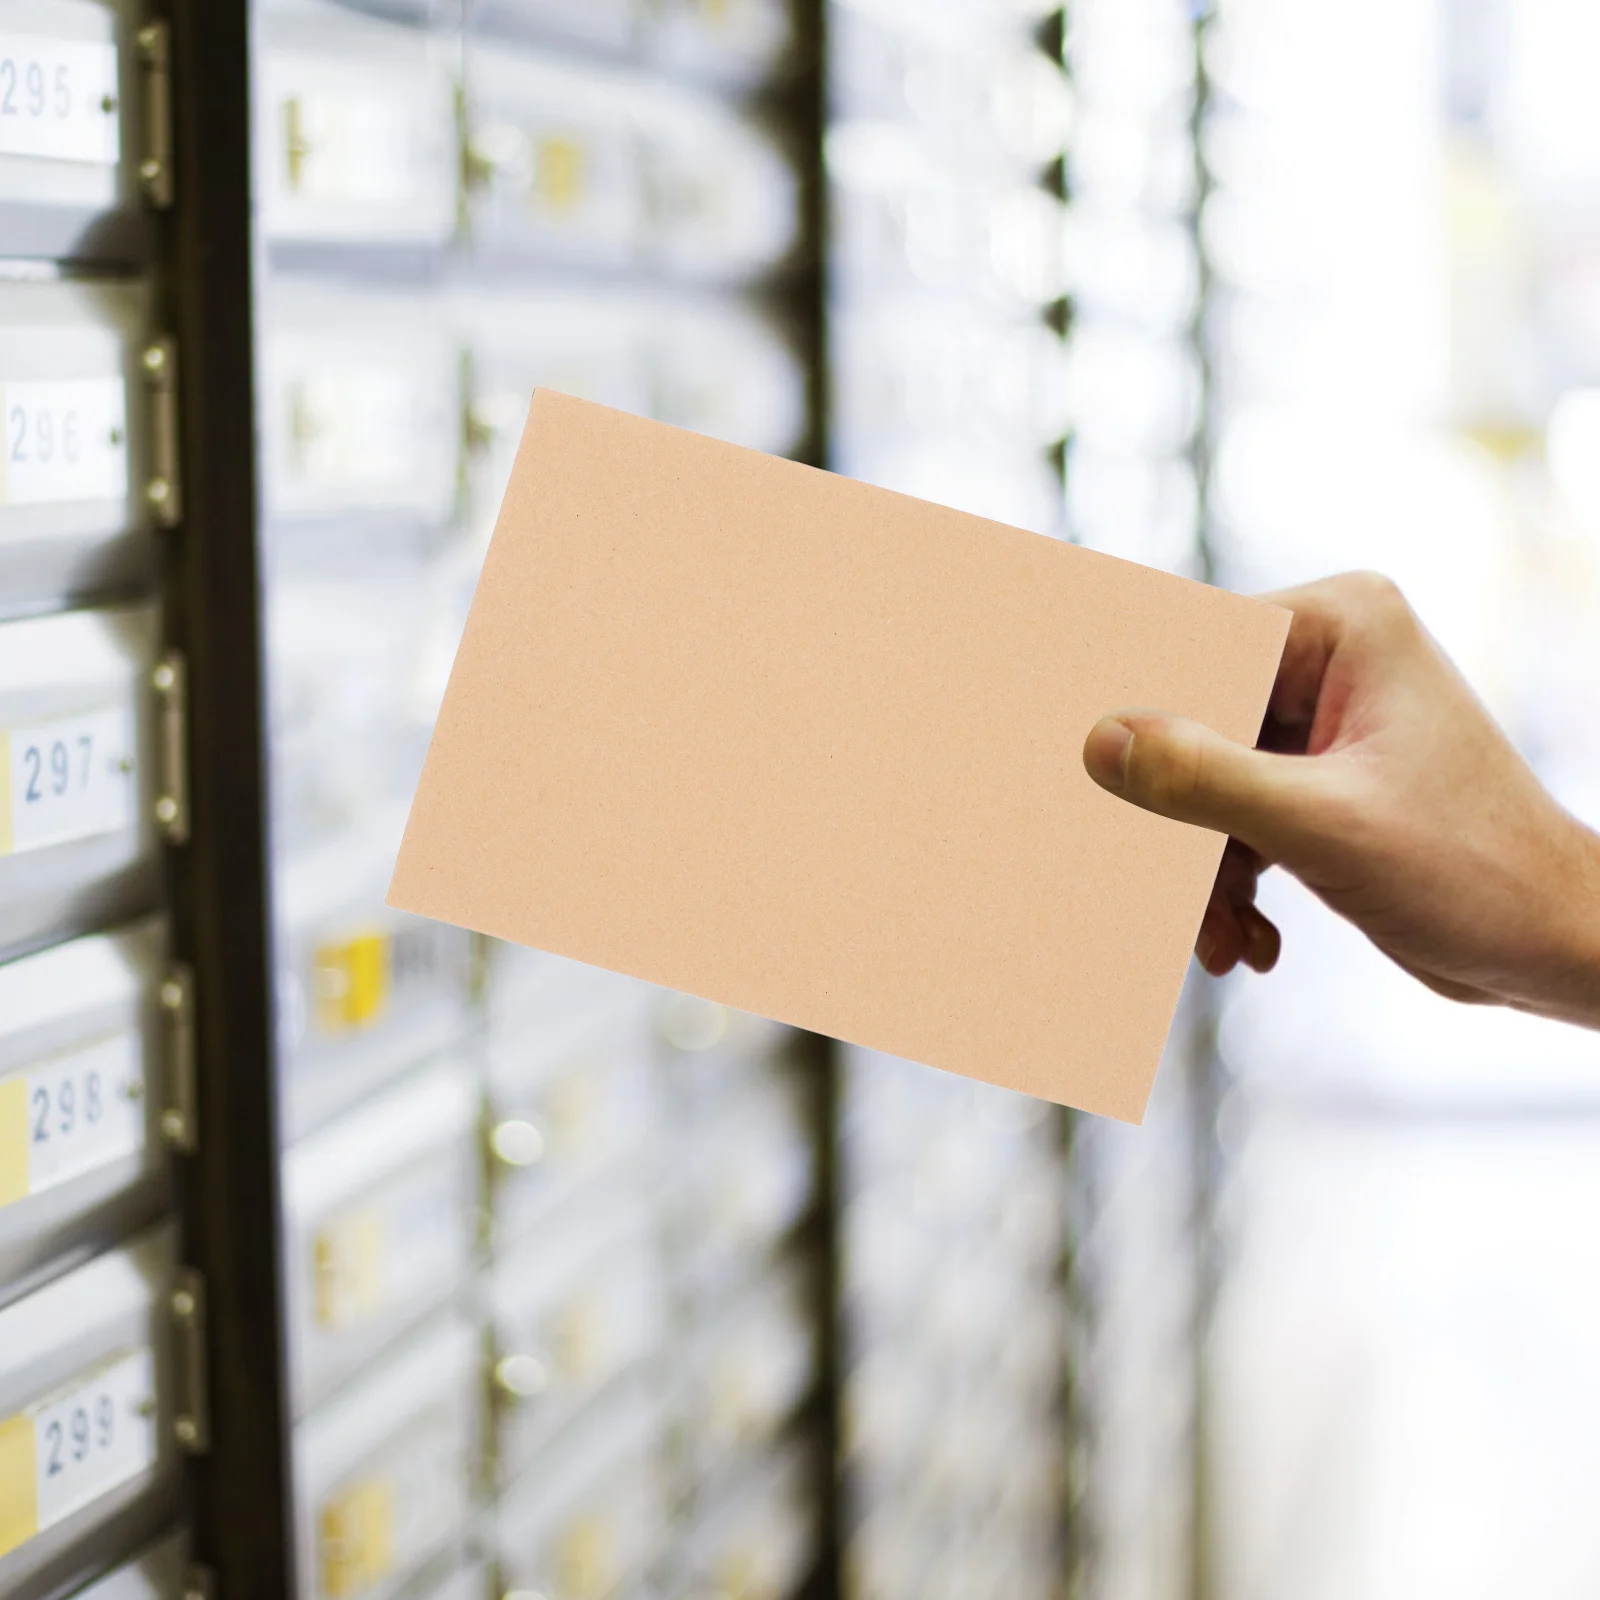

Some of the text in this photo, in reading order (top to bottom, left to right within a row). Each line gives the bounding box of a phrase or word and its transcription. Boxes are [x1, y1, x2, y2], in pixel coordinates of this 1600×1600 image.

[0, 57, 71, 120] 295
[11, 403, 82, 464] 296
[24, 732, 93, 804] 297
[33, 1068, 102, 1145] 298
[45, 1394, 114, 1478] 299
